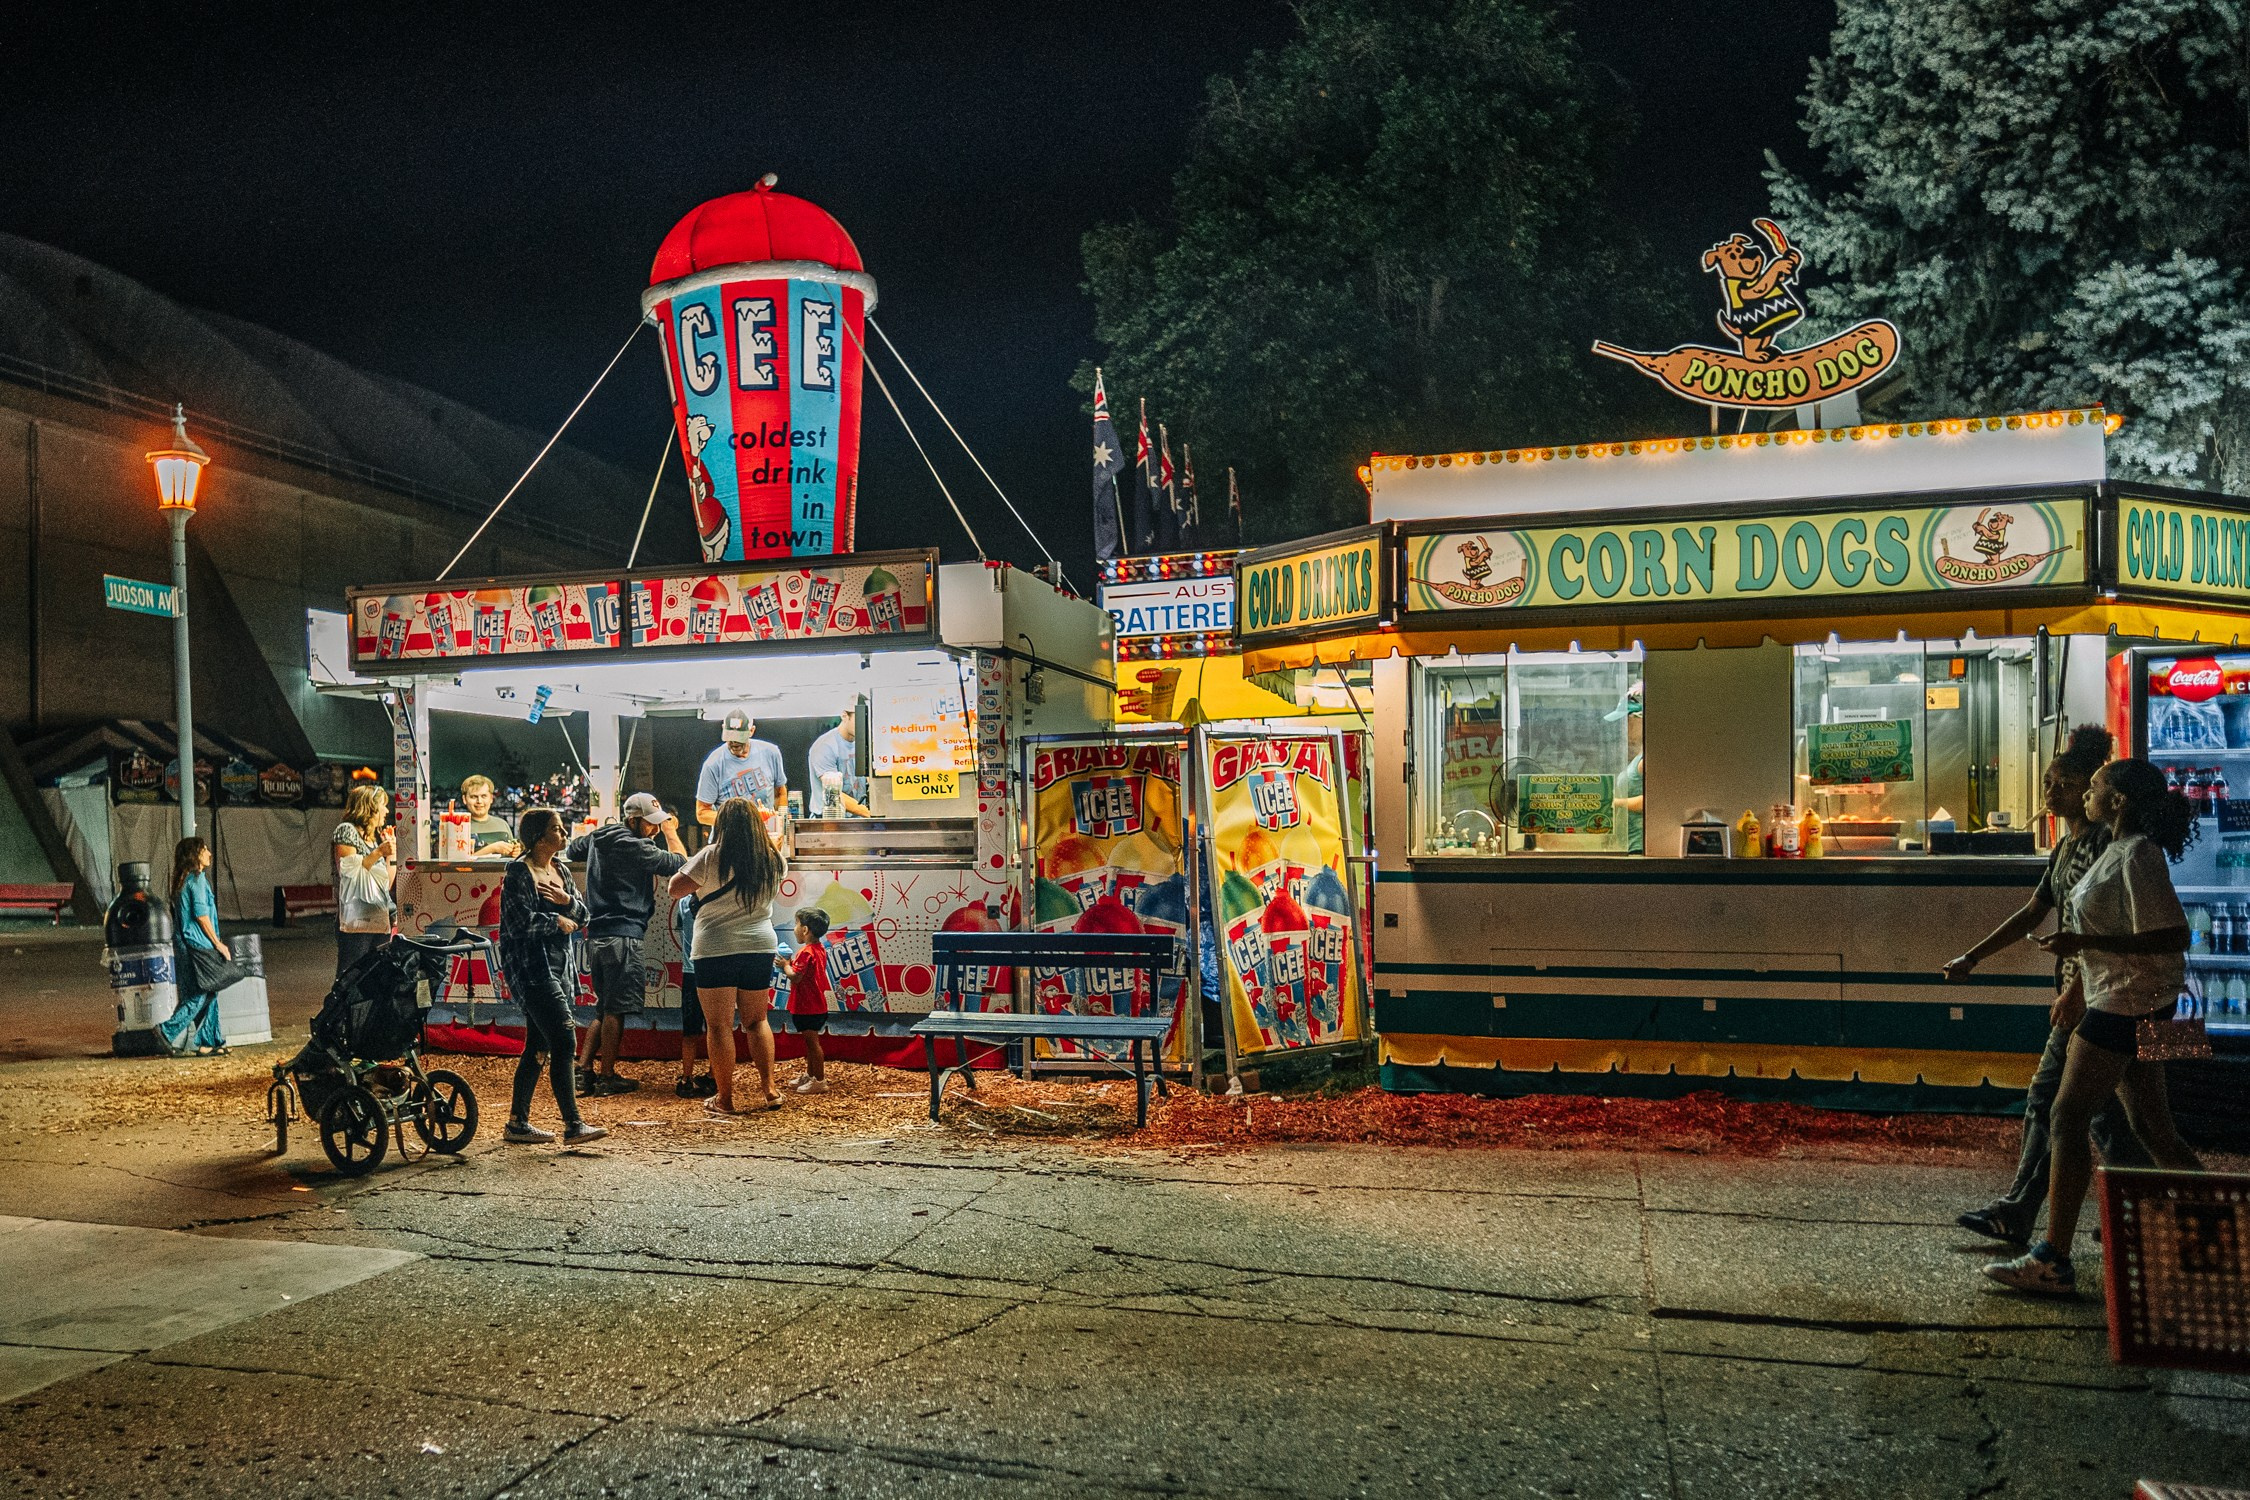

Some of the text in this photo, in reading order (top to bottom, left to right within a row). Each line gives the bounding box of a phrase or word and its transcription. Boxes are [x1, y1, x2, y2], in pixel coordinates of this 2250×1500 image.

[1681, 338, 1883, 399] PONCHO DOG
[727, 421, 828, 450] coldest
[752, 459, 827, 486] drink
[802, 494, 825, 520] in
[751, 526, 824, 549] town
[2126, 507, 2184, 582] COLD
[1547, 515, 1912, 600] CORN DOGS
[1941, 558, 2029, 582] PONCHO DOG
[108, 582, 154, 608] JUDSON
[809, 583, 836, 605] ICEE
[1249, 548, 1373, 630] COLD DRINKS
[1445, 581, 1522, 604] PONCHO DOG
[747, 589, 780, 621] ICEE
[870, 599, 901, 626] ICEE
[1109, 601, 1234, 634] BATTERE
[381, 618, 406, 642] ICEE
[430, 608, 452, 631] ICEE
[476, 613, 505, 638] ICEE
[534, 605, 562, 632] ICEE
[691, 611, 720, 635] ICEE
[2170, 669, 2221, 687] Coca-Cola
[2230, 683, 2250, 691] IC
[890, 723, 937, 734] Medium
[1820, 720, 1897, 734] CORN DOGS
[892, 754, 926, 765] Large
[986, 748, 995, 756] $6
[1821, 747, 1899, 760] CORN DOGS
[1034, 744, 1130, 792] GRAB
[1212, 741, 1292, 791] GRAB
[896, 773, 949, 785] CASH $$
[921, 784, 954, 795] ONLY
[986, 779, 995, 787] $9
[1530, 775, 1601, 784] CORN DOGS
[1080, 785, 1134, 824] ICEE
[1255, 779, 1295, 817] ICEE
[1530, 801, 1601, 810] CORN DOGS
[825, 932, 877, 982] ICEE
[1309, 928, 1342, 963] ICEE
[1271, 949, 1305, 986] ICEE
